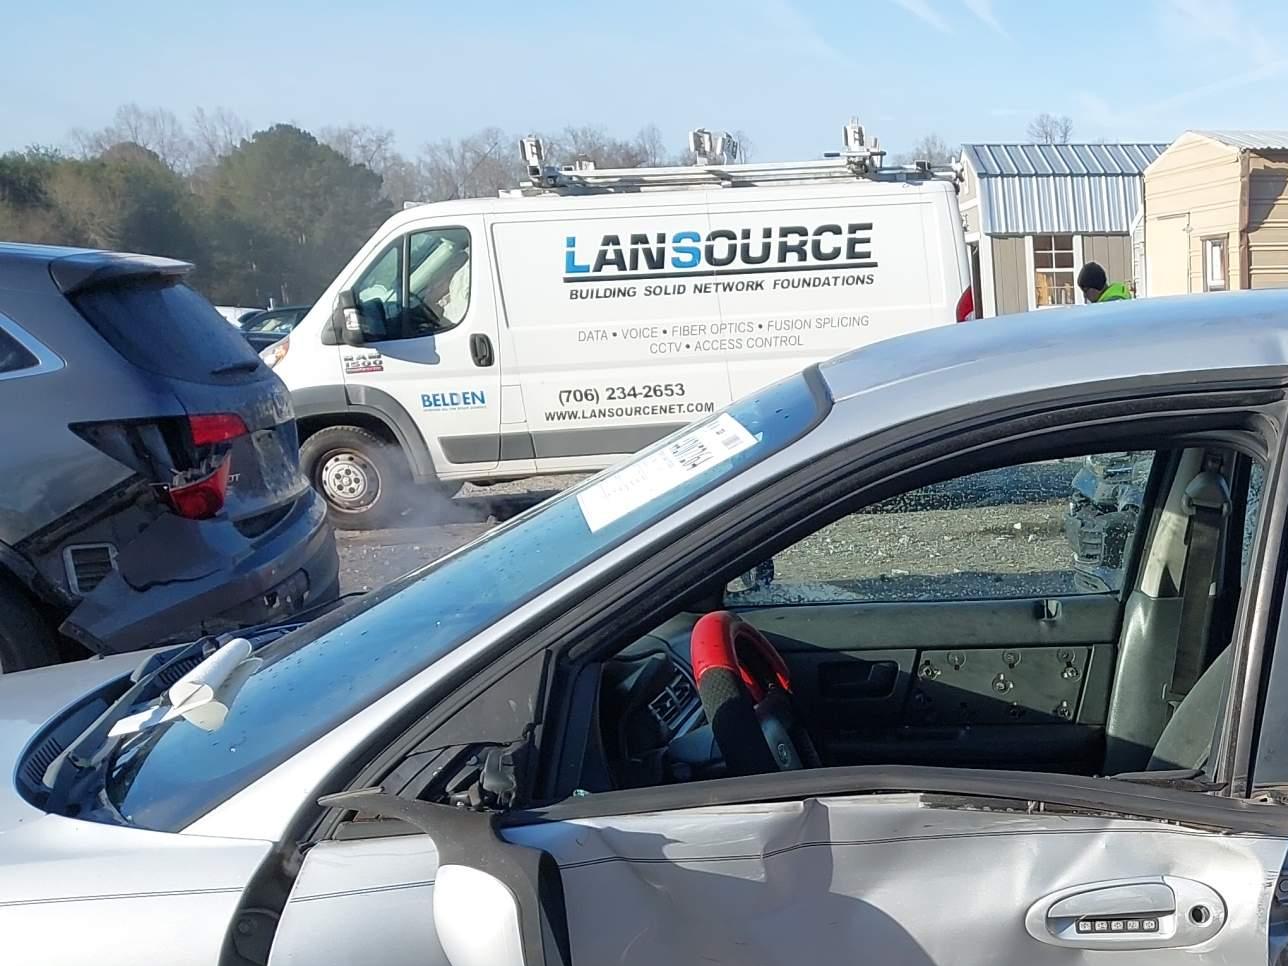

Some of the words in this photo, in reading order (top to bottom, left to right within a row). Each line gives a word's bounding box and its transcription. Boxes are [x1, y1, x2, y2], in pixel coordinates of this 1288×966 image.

[565, 222, 874, 274] LANSOURCE
[569, 286, 637, 300] BUILDING
[644, 283, 687, 297] SOLID
[693, 279, 765, 294] NETWORK
[772, 274, 875, 291] FOUNDATIONS
[578, 330, 608, 342] DATA
[621, 327, 659, 339] VOICE
[671, 324, 706, 337] FIBER
[710, 321, 755, 335] OPTICS
[767, 318, 812, 332] FUSION
[815, 315, 870, 329] SPLICING
[650, 342, 682, 354] CCTV
[694, 338, 743, 352] ACCESS
[746, 335, 804, 349] CONTROL
[421, 390, 486, 408] BELDEN
[558, 388, 600, 406] (706)
[605, 383, 686, 400] 234-2653
[545, 402, 715, 421] WWW.LANSOURCENET.COM
